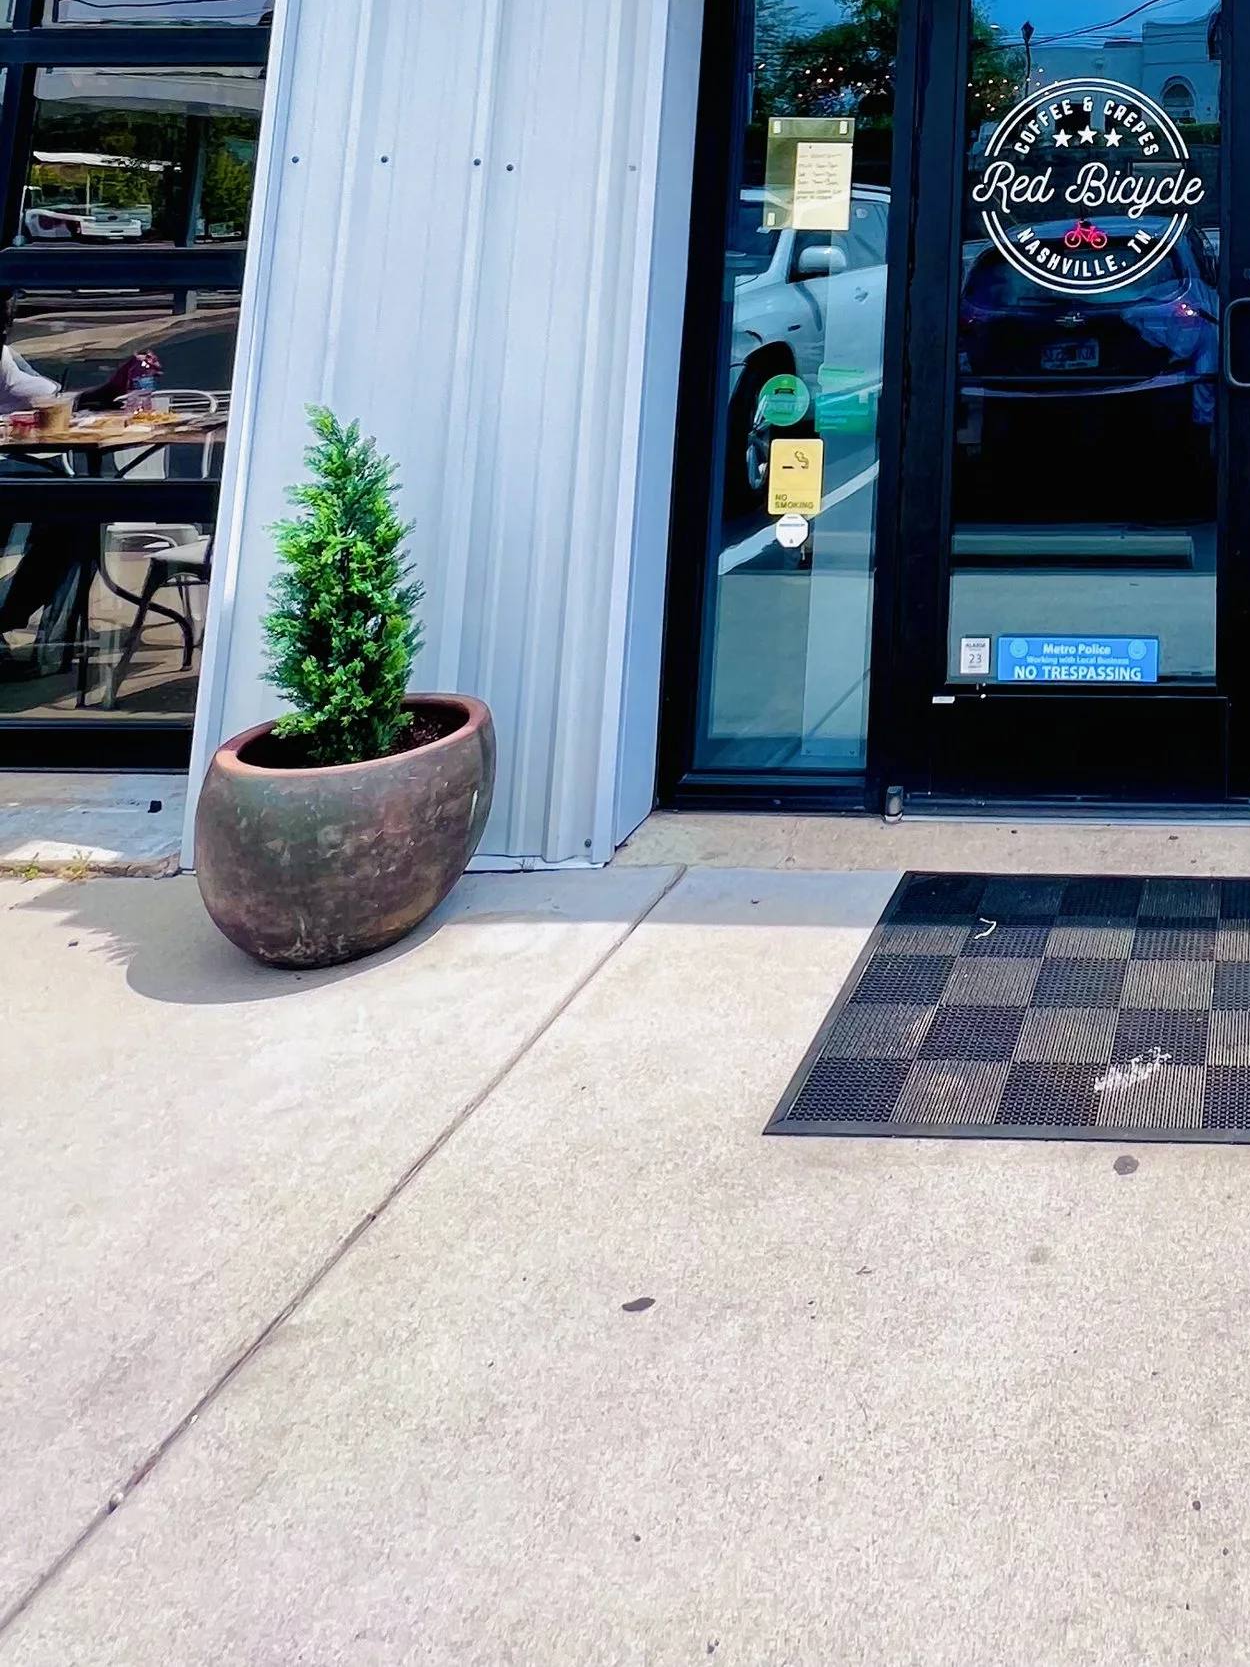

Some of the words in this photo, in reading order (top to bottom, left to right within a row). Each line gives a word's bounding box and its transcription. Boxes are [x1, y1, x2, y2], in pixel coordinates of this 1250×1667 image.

[1013, 98, 1074, 155] COFFEE
[1082, 96, 1093, 112] &
[1103, 99, 1159, 156] CREPES
[972, 160, 1055, 214] Red
[1064, 161, 1205, 220] Bicycle
[1016, 226, 1127, 277] NASHVILLE,
[775, 493, 788, 502] NO
[775, 501, 814, 509] SMOKING
[1043, 643, 1077, 655] Metro
[1078, 644, 1112, 655] Police
[969, 653, 982, 664] 23
[1014, 665, 1038, 680] NO
[1041, 665, 1142, 681] TRESPASSING
